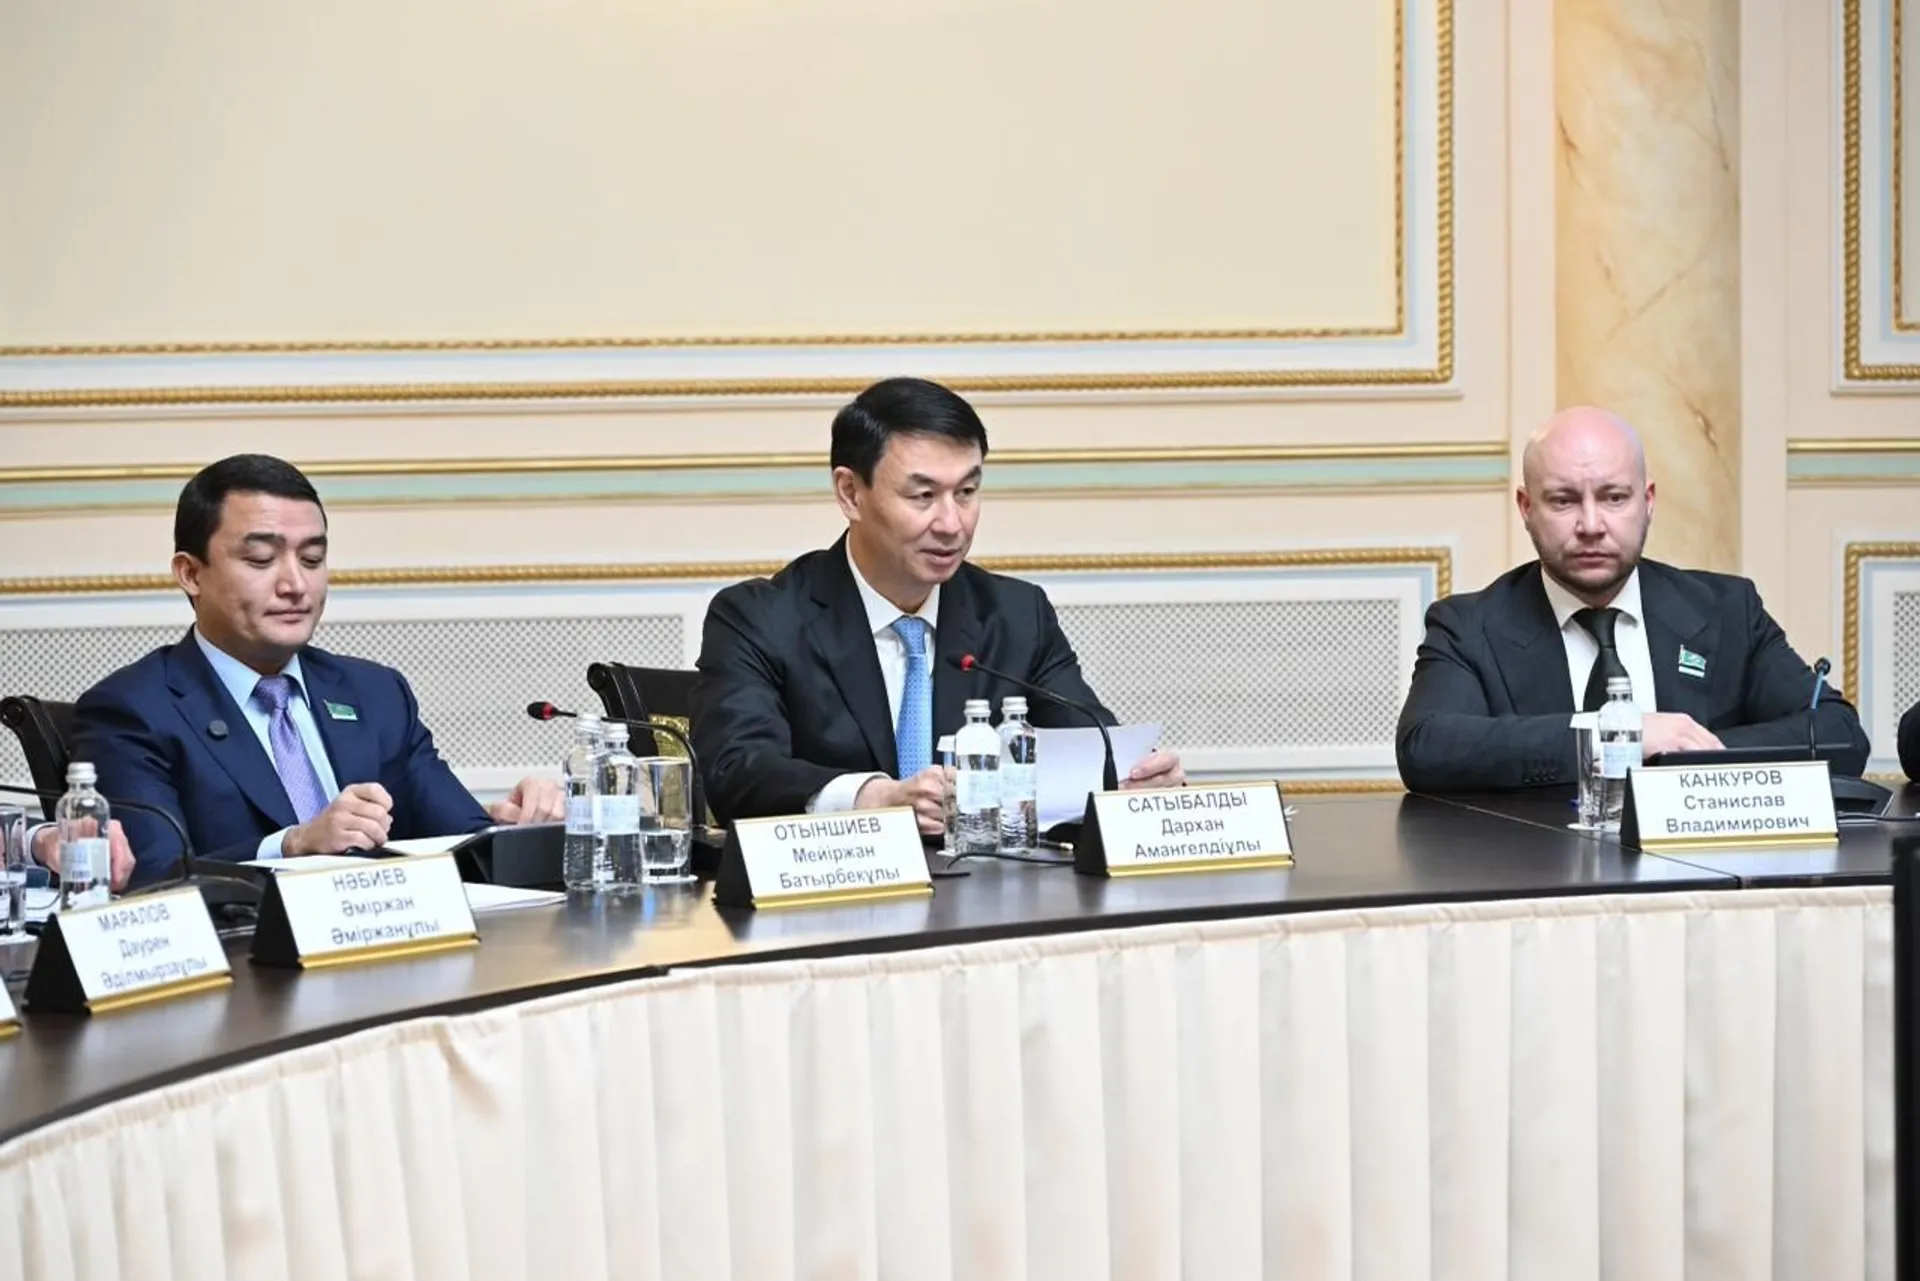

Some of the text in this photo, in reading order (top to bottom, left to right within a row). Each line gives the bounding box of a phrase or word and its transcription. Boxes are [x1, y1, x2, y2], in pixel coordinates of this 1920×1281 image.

[1680, 770, 1783, 788] КАНКУРОВ
[1128, 791, 1247, 813] САТЫБАЛДЫ
[1684, 795, 1785, 811] Станислав
[774, 817, 881, 841] ОТЫНШИЕВ
[1161, 818, 1224, 836] Дархан
[1666, 816, 1809, 833] Владимирович
[792, 844, 875, 863] Мейіржан
[1135, 838, 1261, 858] Амангелдіұлы
[332, 867, 407, 892] НӘБИЕВ
[779, 867, 900, 889] Батырбекұлы
[97, 902, 171, 932] МАРАЛОВ
[341, 896, 415, 918] Әміржан
